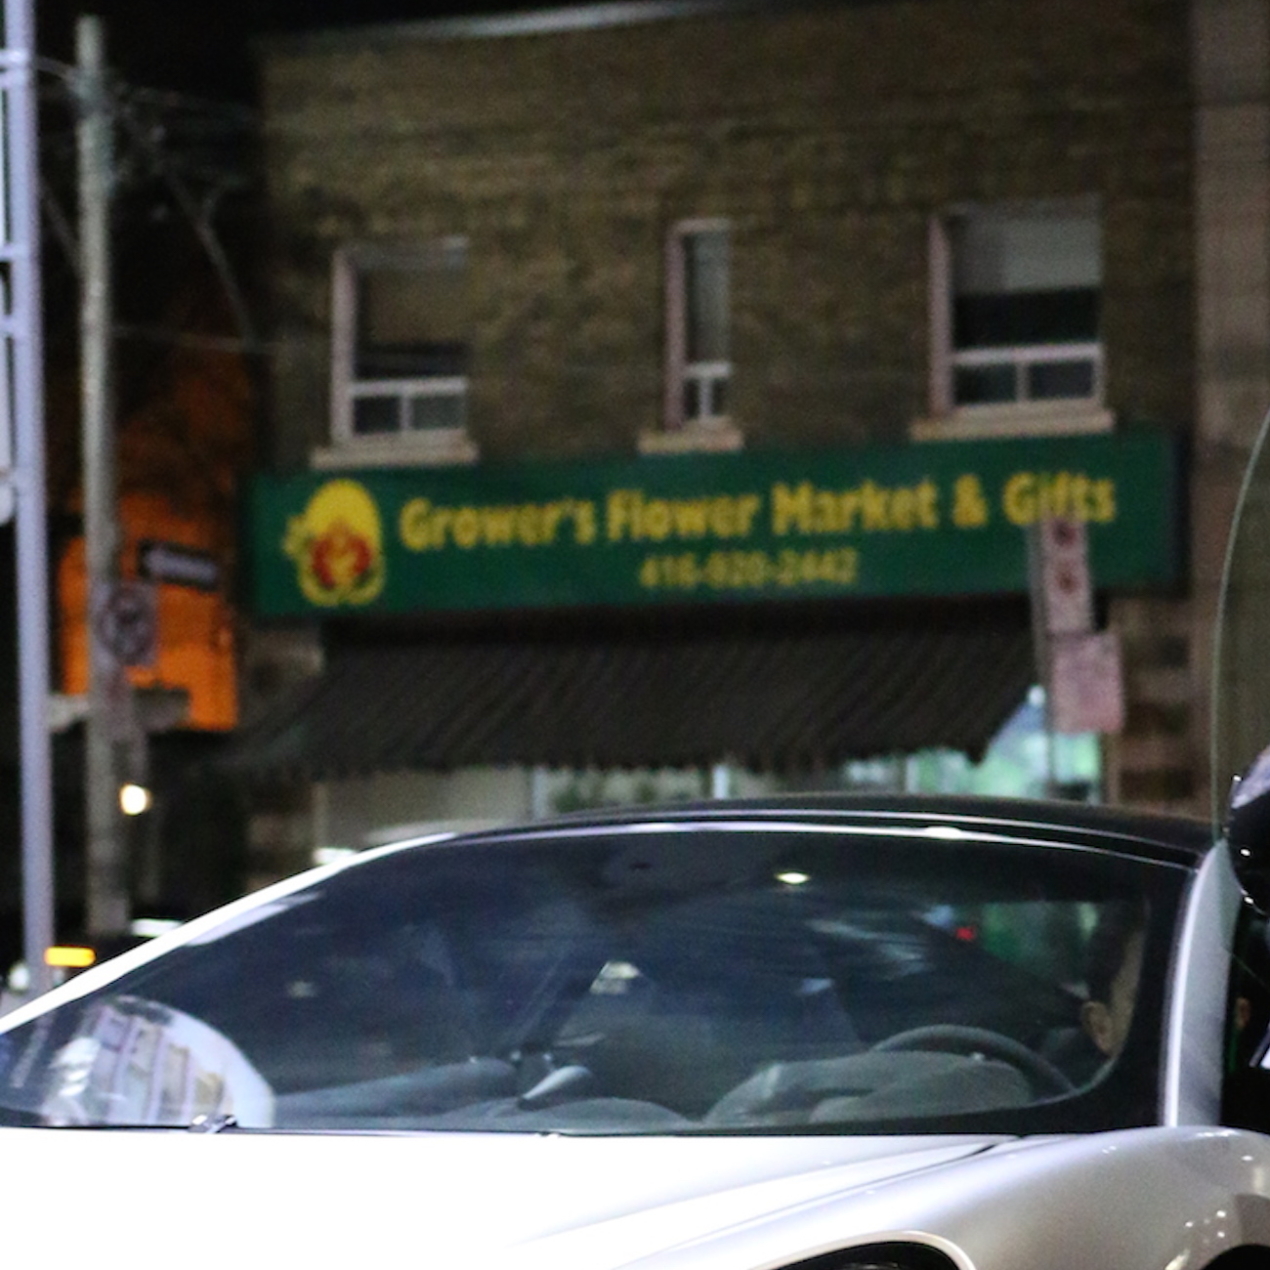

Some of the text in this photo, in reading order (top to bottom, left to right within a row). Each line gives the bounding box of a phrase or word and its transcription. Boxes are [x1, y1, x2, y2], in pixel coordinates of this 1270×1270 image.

[607, 488, 760, 542] Flower
[771, 478, 938, 536] Market
[952, 473, 987, 527] &
[1003, 471, 1116, 526] Gifts
